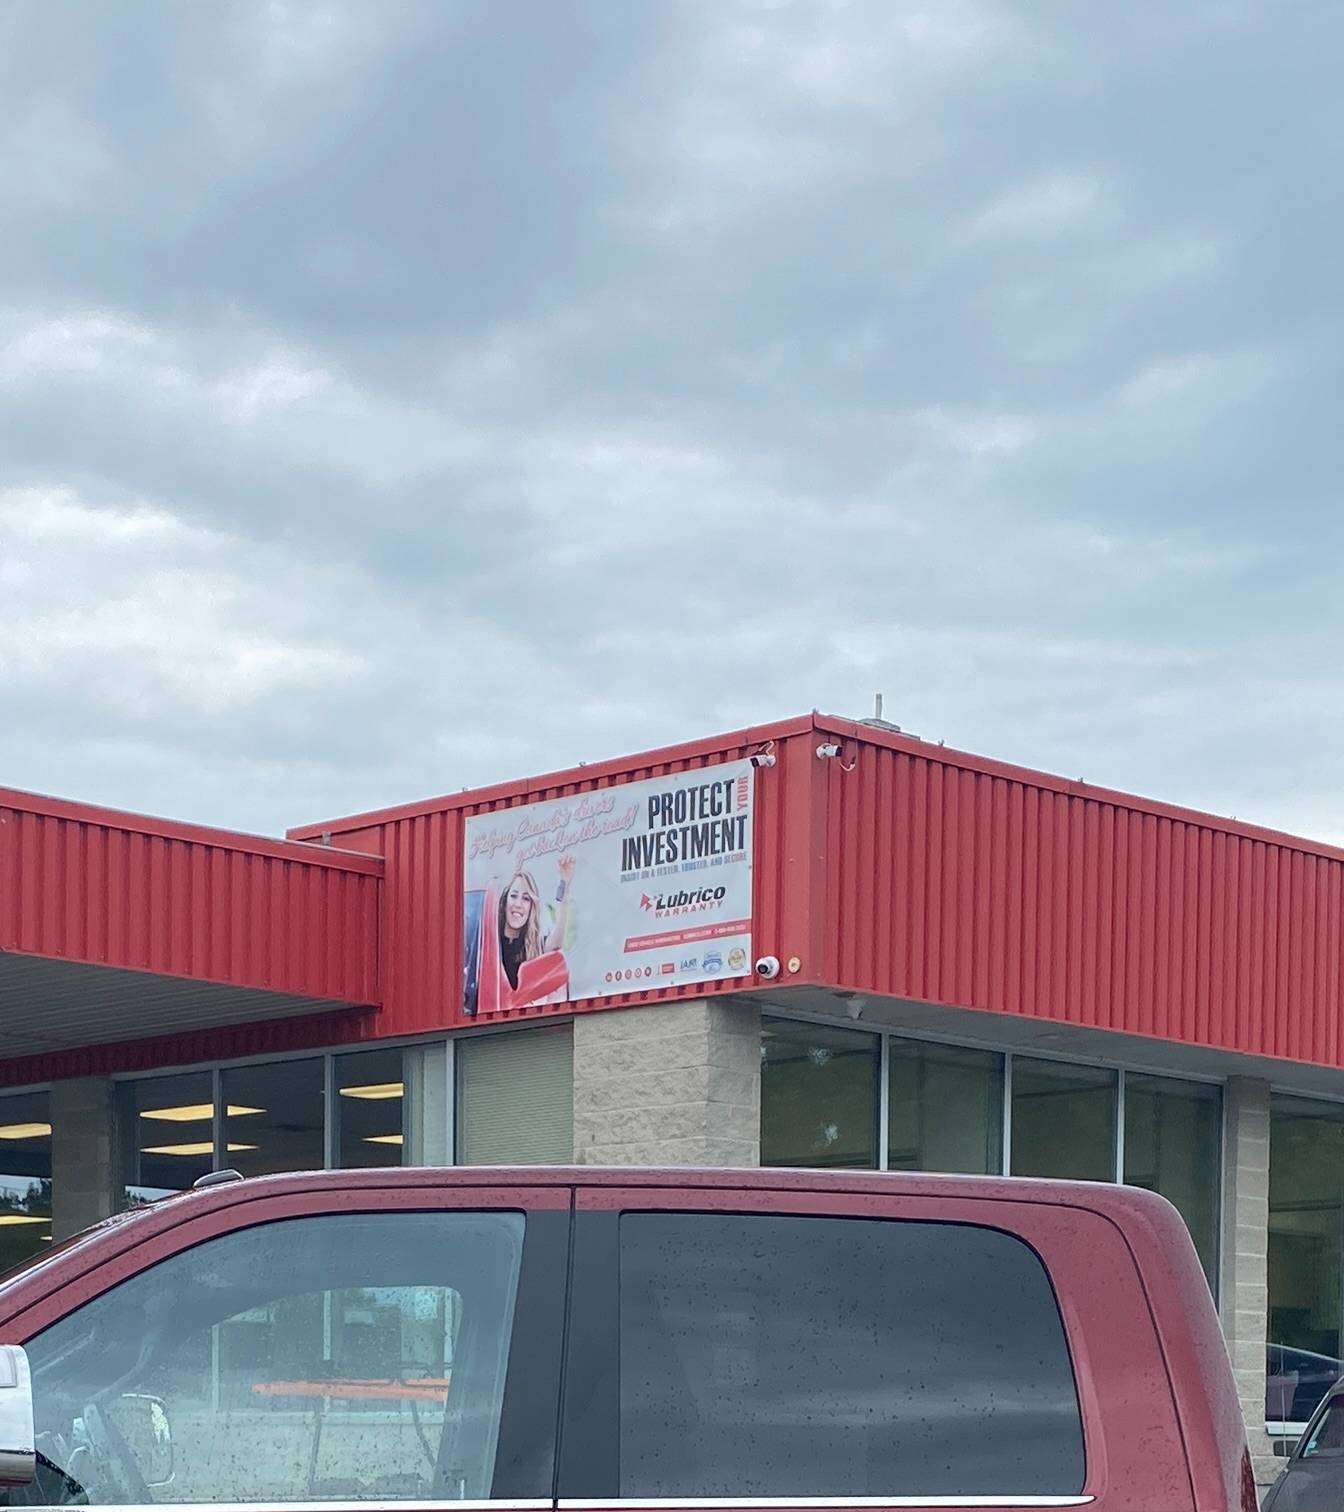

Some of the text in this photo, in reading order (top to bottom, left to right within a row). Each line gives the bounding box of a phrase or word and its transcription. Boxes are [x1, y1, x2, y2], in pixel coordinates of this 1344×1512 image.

[648, 778, 735, 829] PROTECT
[737, 776, 749, 811] YOUR
[622, 815, 748, 872] INVESTMENT
[655, 900, 726, 918] WARRANTY
[656, 886, 726, 910] Lubrico
